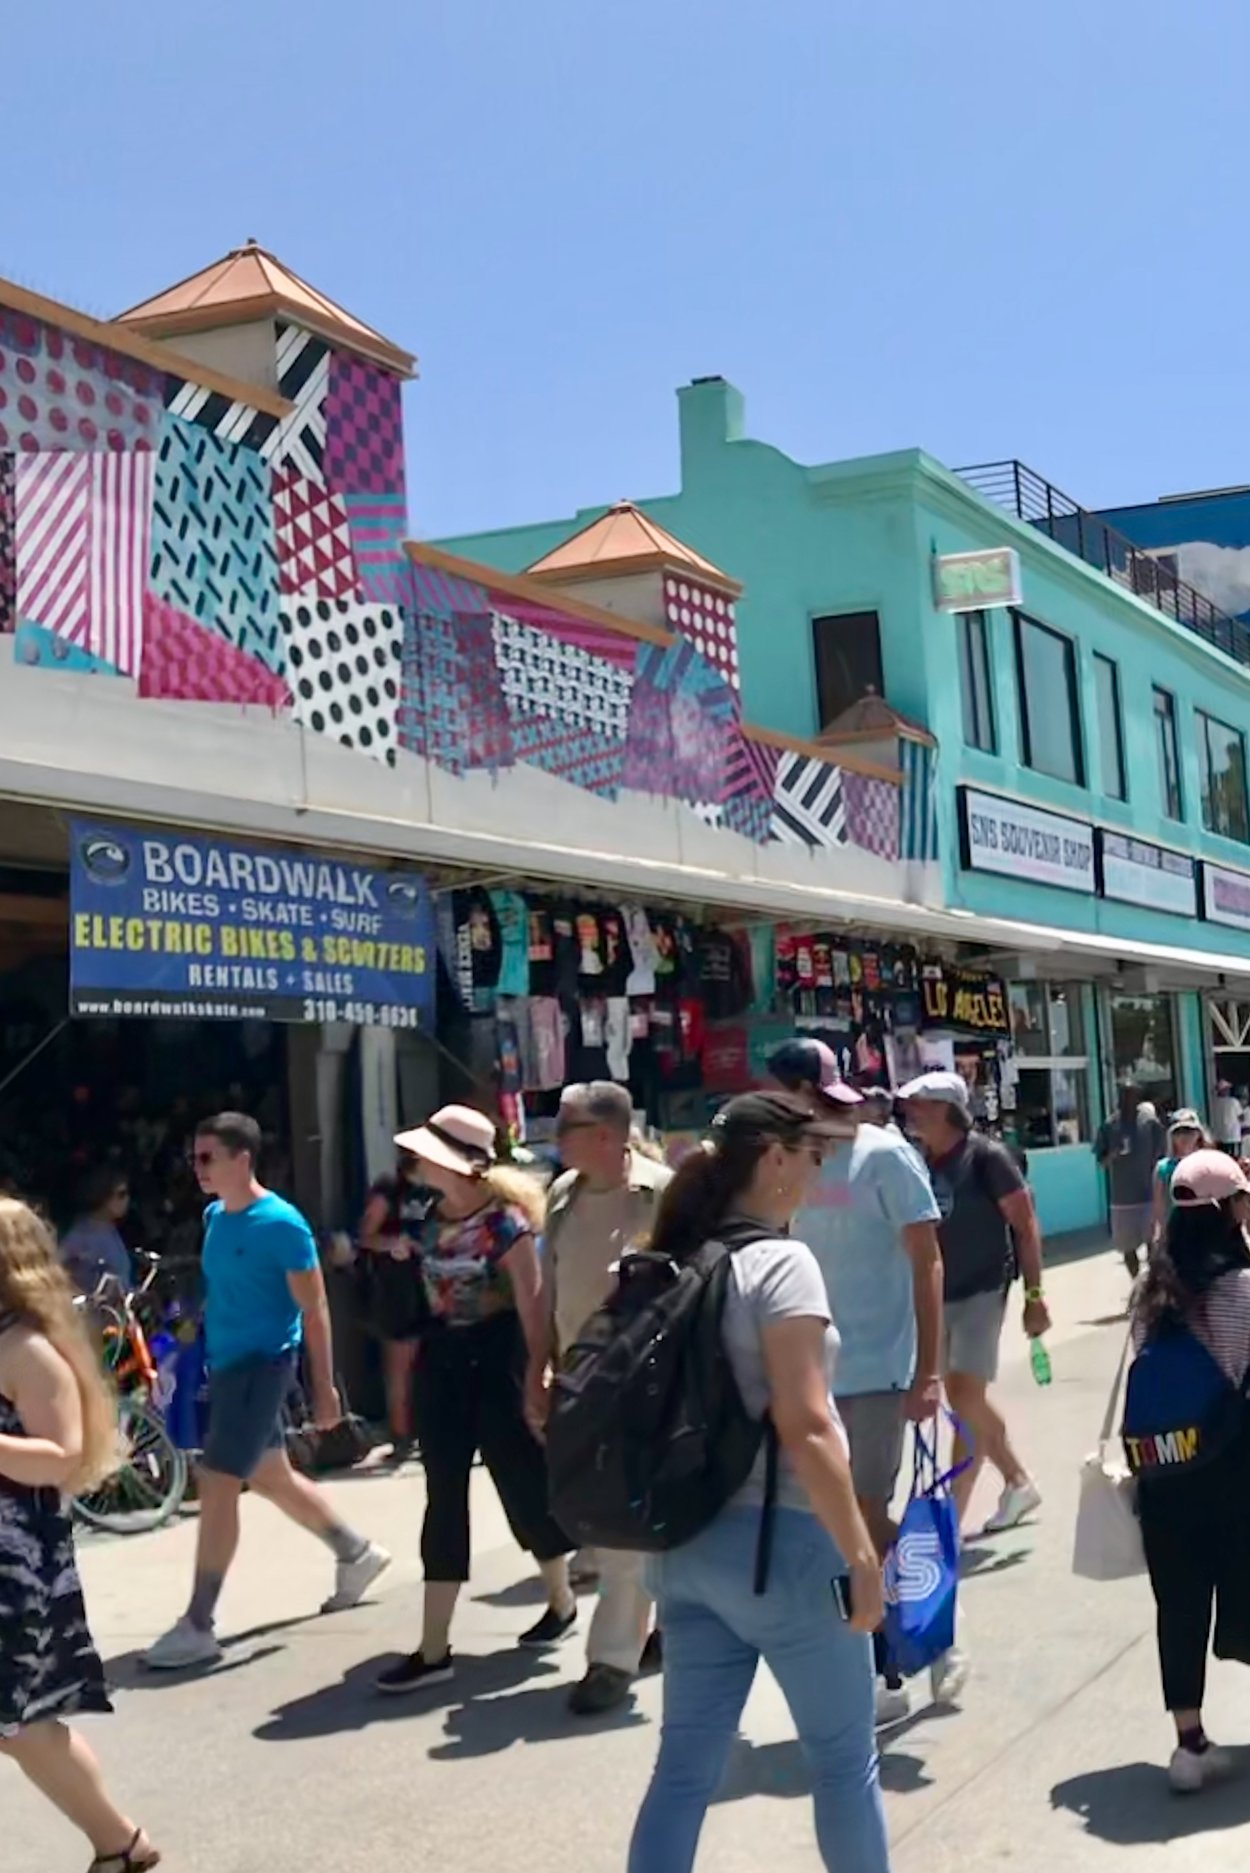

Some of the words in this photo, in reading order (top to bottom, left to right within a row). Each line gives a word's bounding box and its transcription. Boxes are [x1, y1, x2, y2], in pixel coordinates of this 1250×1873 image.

[1001, 821, 1062, 865] SOUVENIR
[143, 840, 379, 908] BOARDWALK
[143, 888, 220, 918] BIKES
[241, 900, 315, 928] SKATE
[331, 909, 383, 936] SURF
[74, 913, 212, 955] ELECTRIC
[221, 926, 296, 961] BIKES
[303, 938, 317, 960] &
[323, 934, 426, 974] SCOOTERS
[188, 963, 278, 991] RENTALS
[303, 972, 354, 995] SALES
